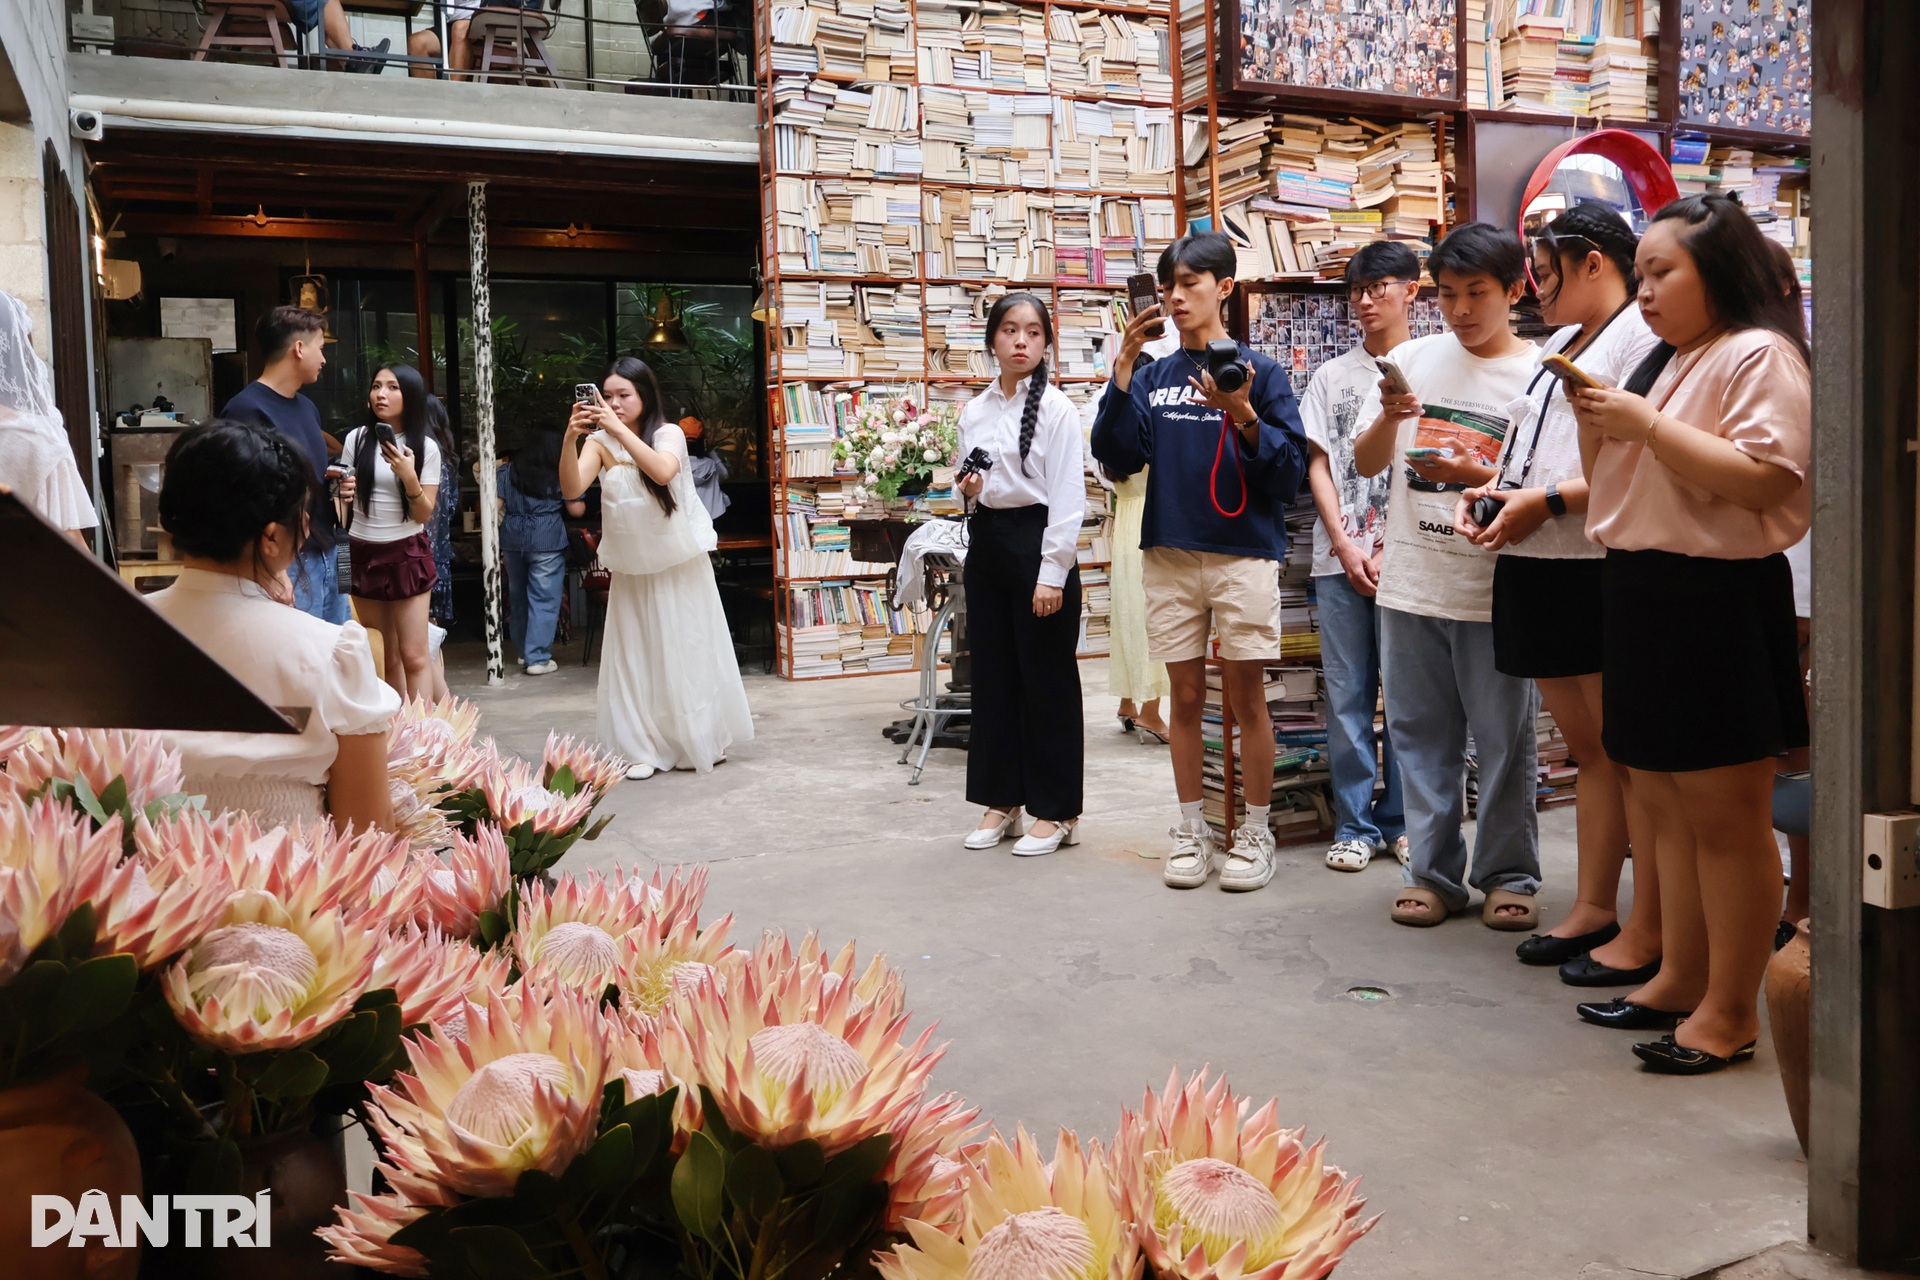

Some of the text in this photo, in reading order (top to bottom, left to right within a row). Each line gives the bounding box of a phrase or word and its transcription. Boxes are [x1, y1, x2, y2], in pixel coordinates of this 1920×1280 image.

[1341, 386, 1356, 399] THE
[1440, 397, 1453, 405] THE
[1419, 520, 1455, 536] SAAB
